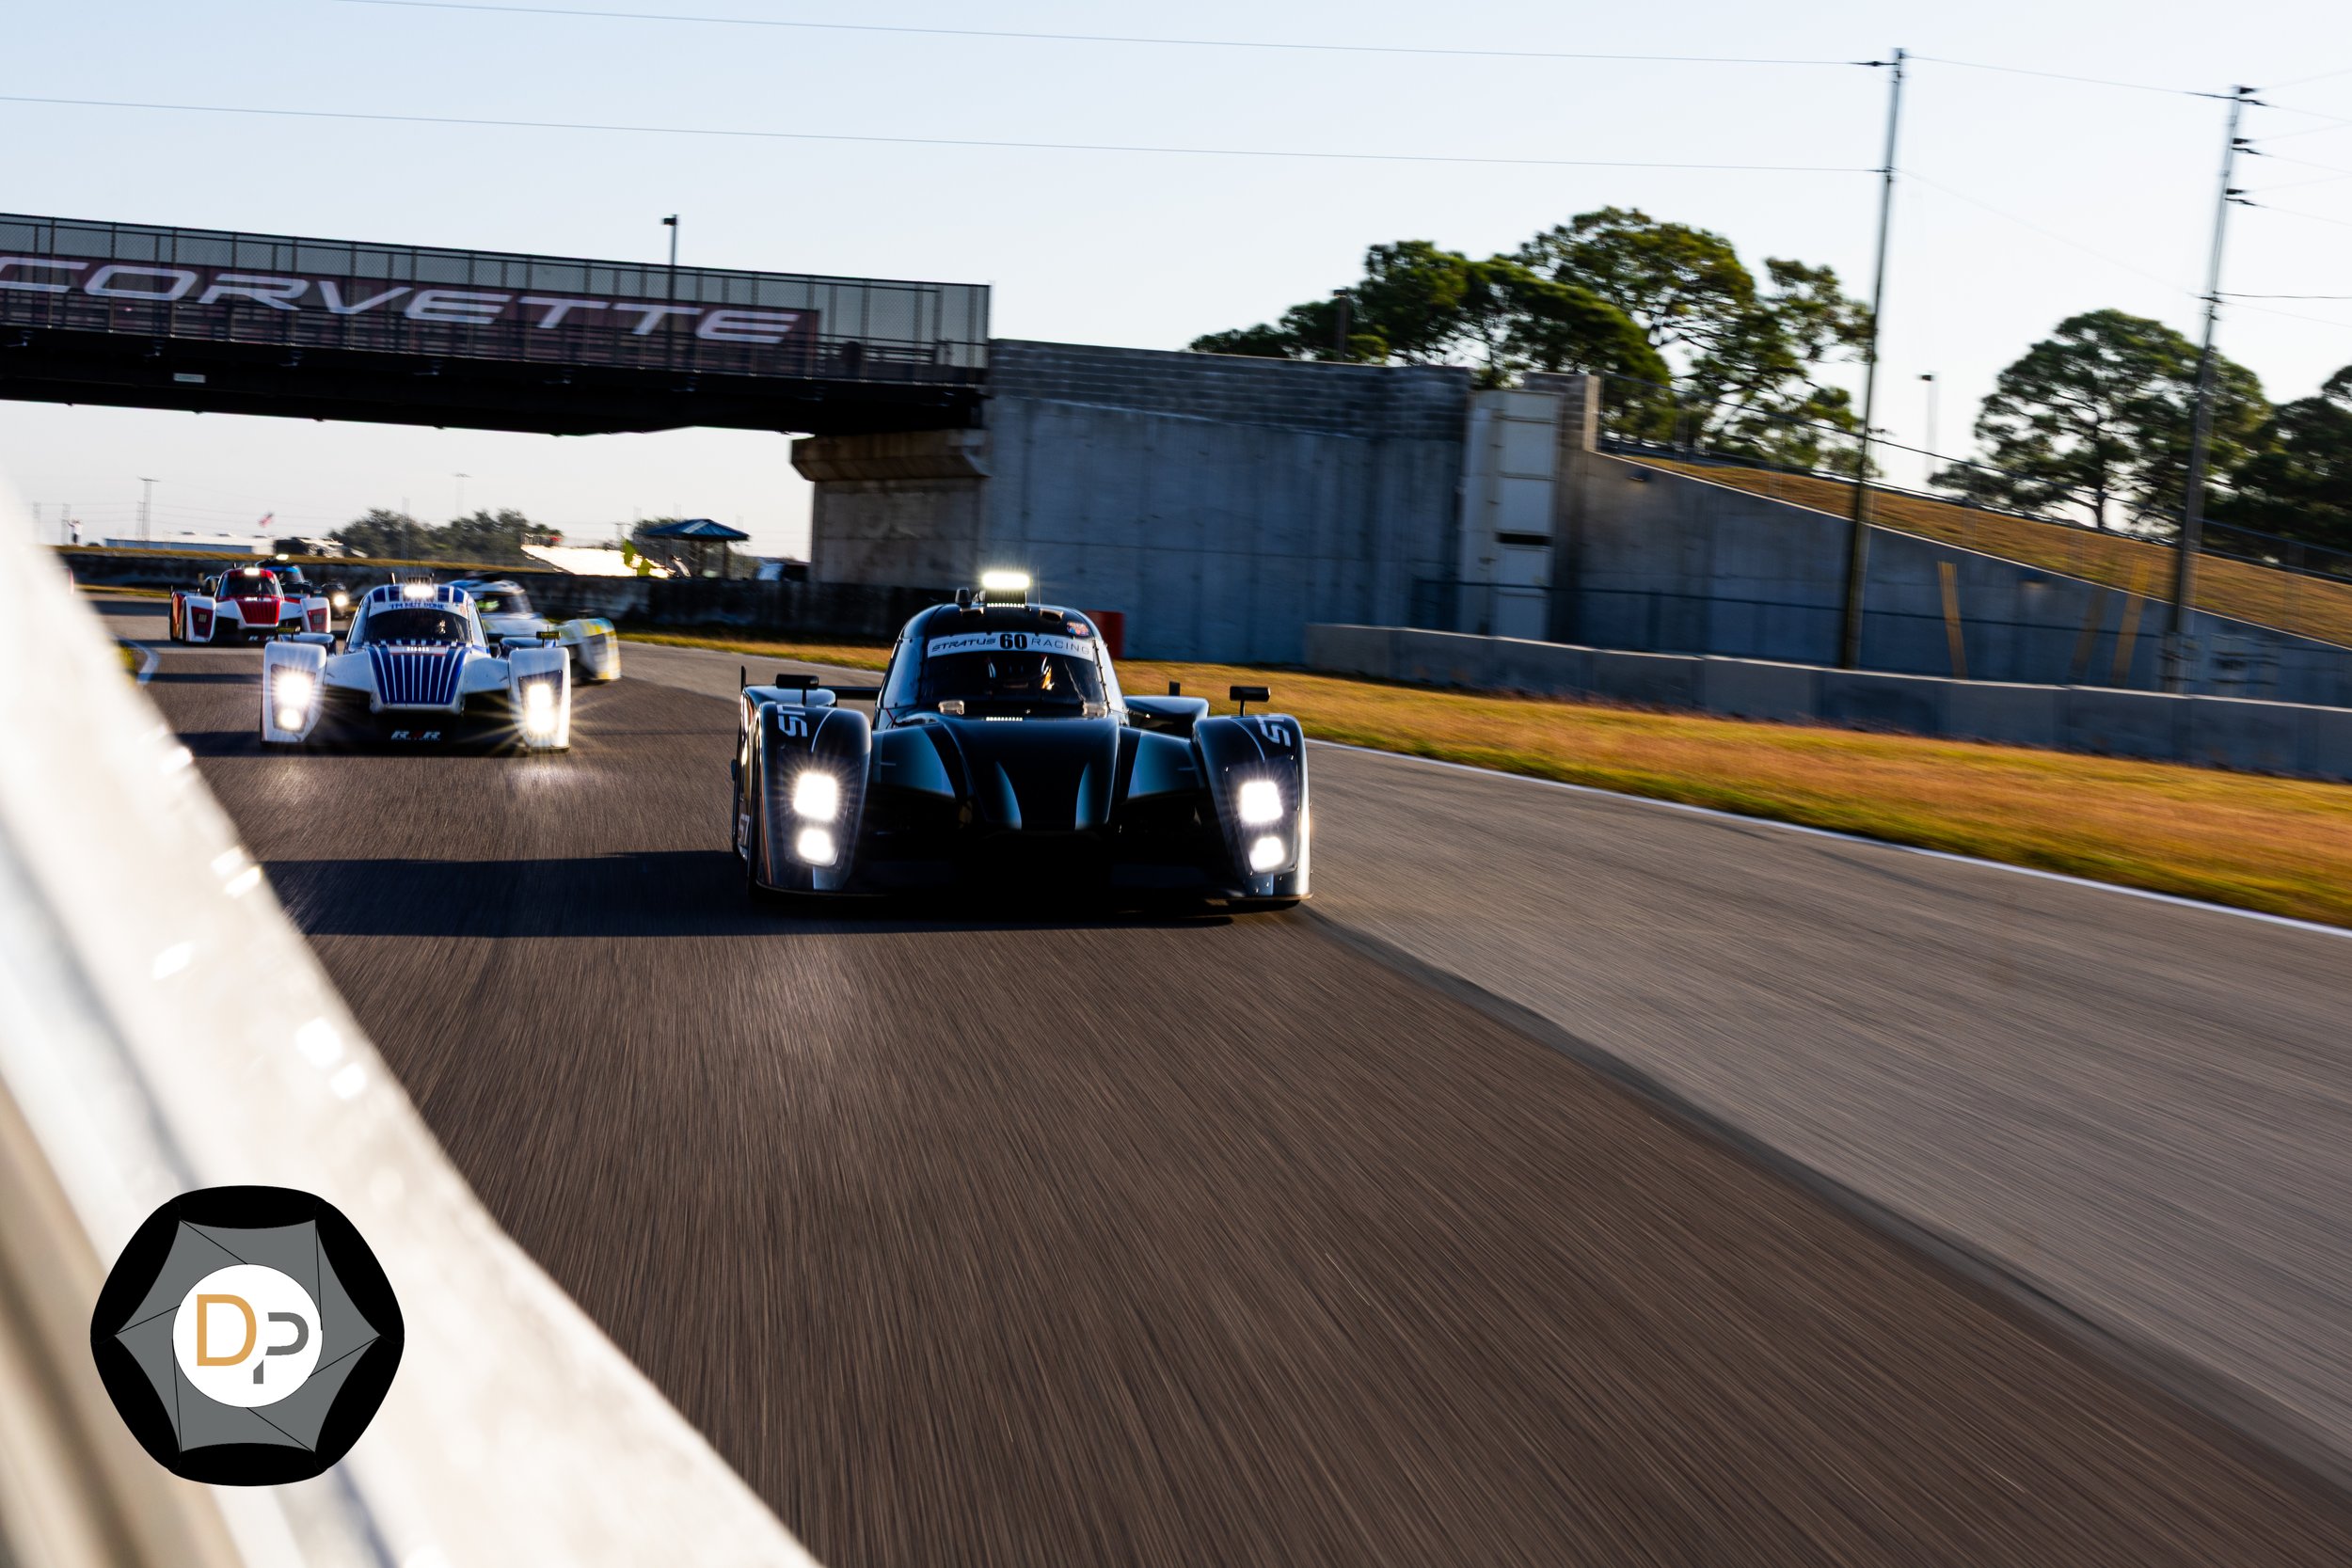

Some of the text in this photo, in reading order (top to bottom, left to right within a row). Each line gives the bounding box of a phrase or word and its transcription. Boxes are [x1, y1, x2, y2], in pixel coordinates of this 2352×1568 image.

[0, 256, 801, 344] CORVETTE
[931, 633, 1090, 655] STRATUS 60 RACING
